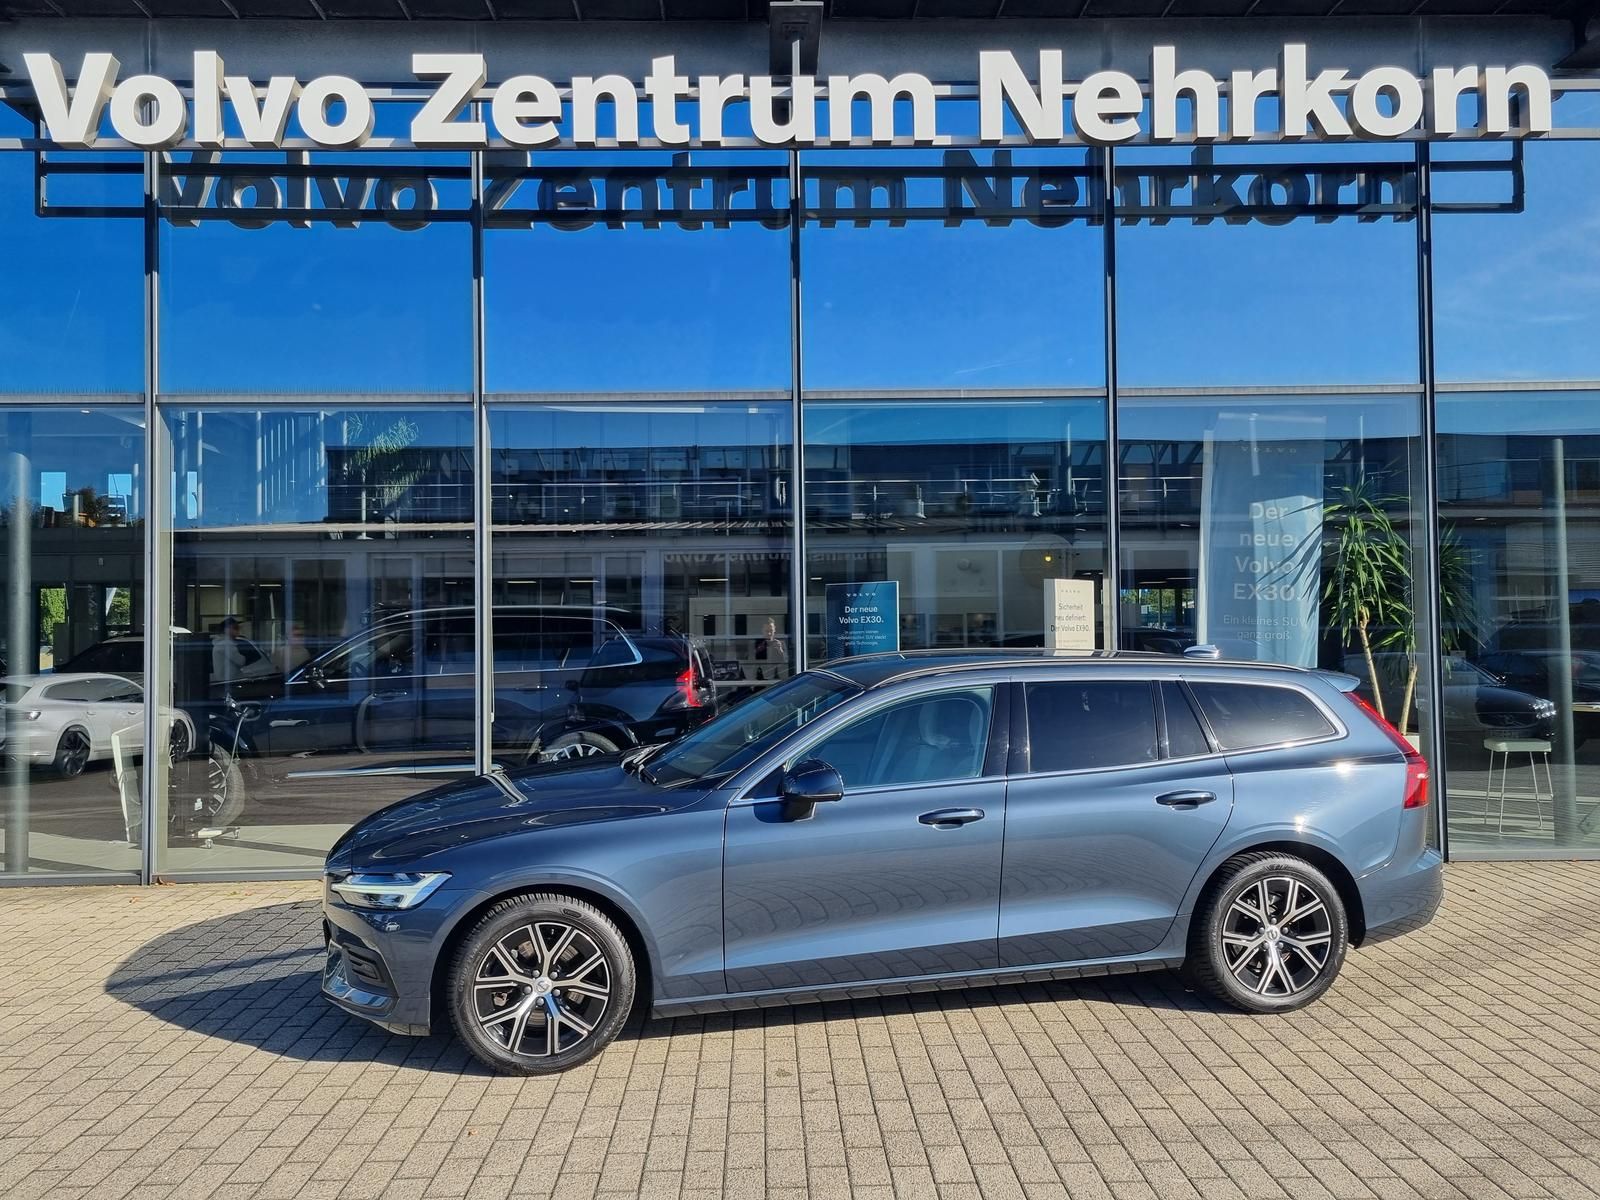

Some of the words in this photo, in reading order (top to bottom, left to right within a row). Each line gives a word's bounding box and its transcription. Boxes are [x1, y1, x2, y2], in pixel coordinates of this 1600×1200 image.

[23, 50, 375, 148] Volvo
[411, 53, 942, 147] Zentrum
[979, 43, 1552, 144] Nehrkorn
[1250, 502, 1289, 520] Der
[1239, 533, 1295, 547] neue
[1235, 556, 1294, 574] Volvo
[844, 606, 858, 614] Der
[838, 615, 859, 624] Volvo
[860, 615, 884, 624] EX30.
